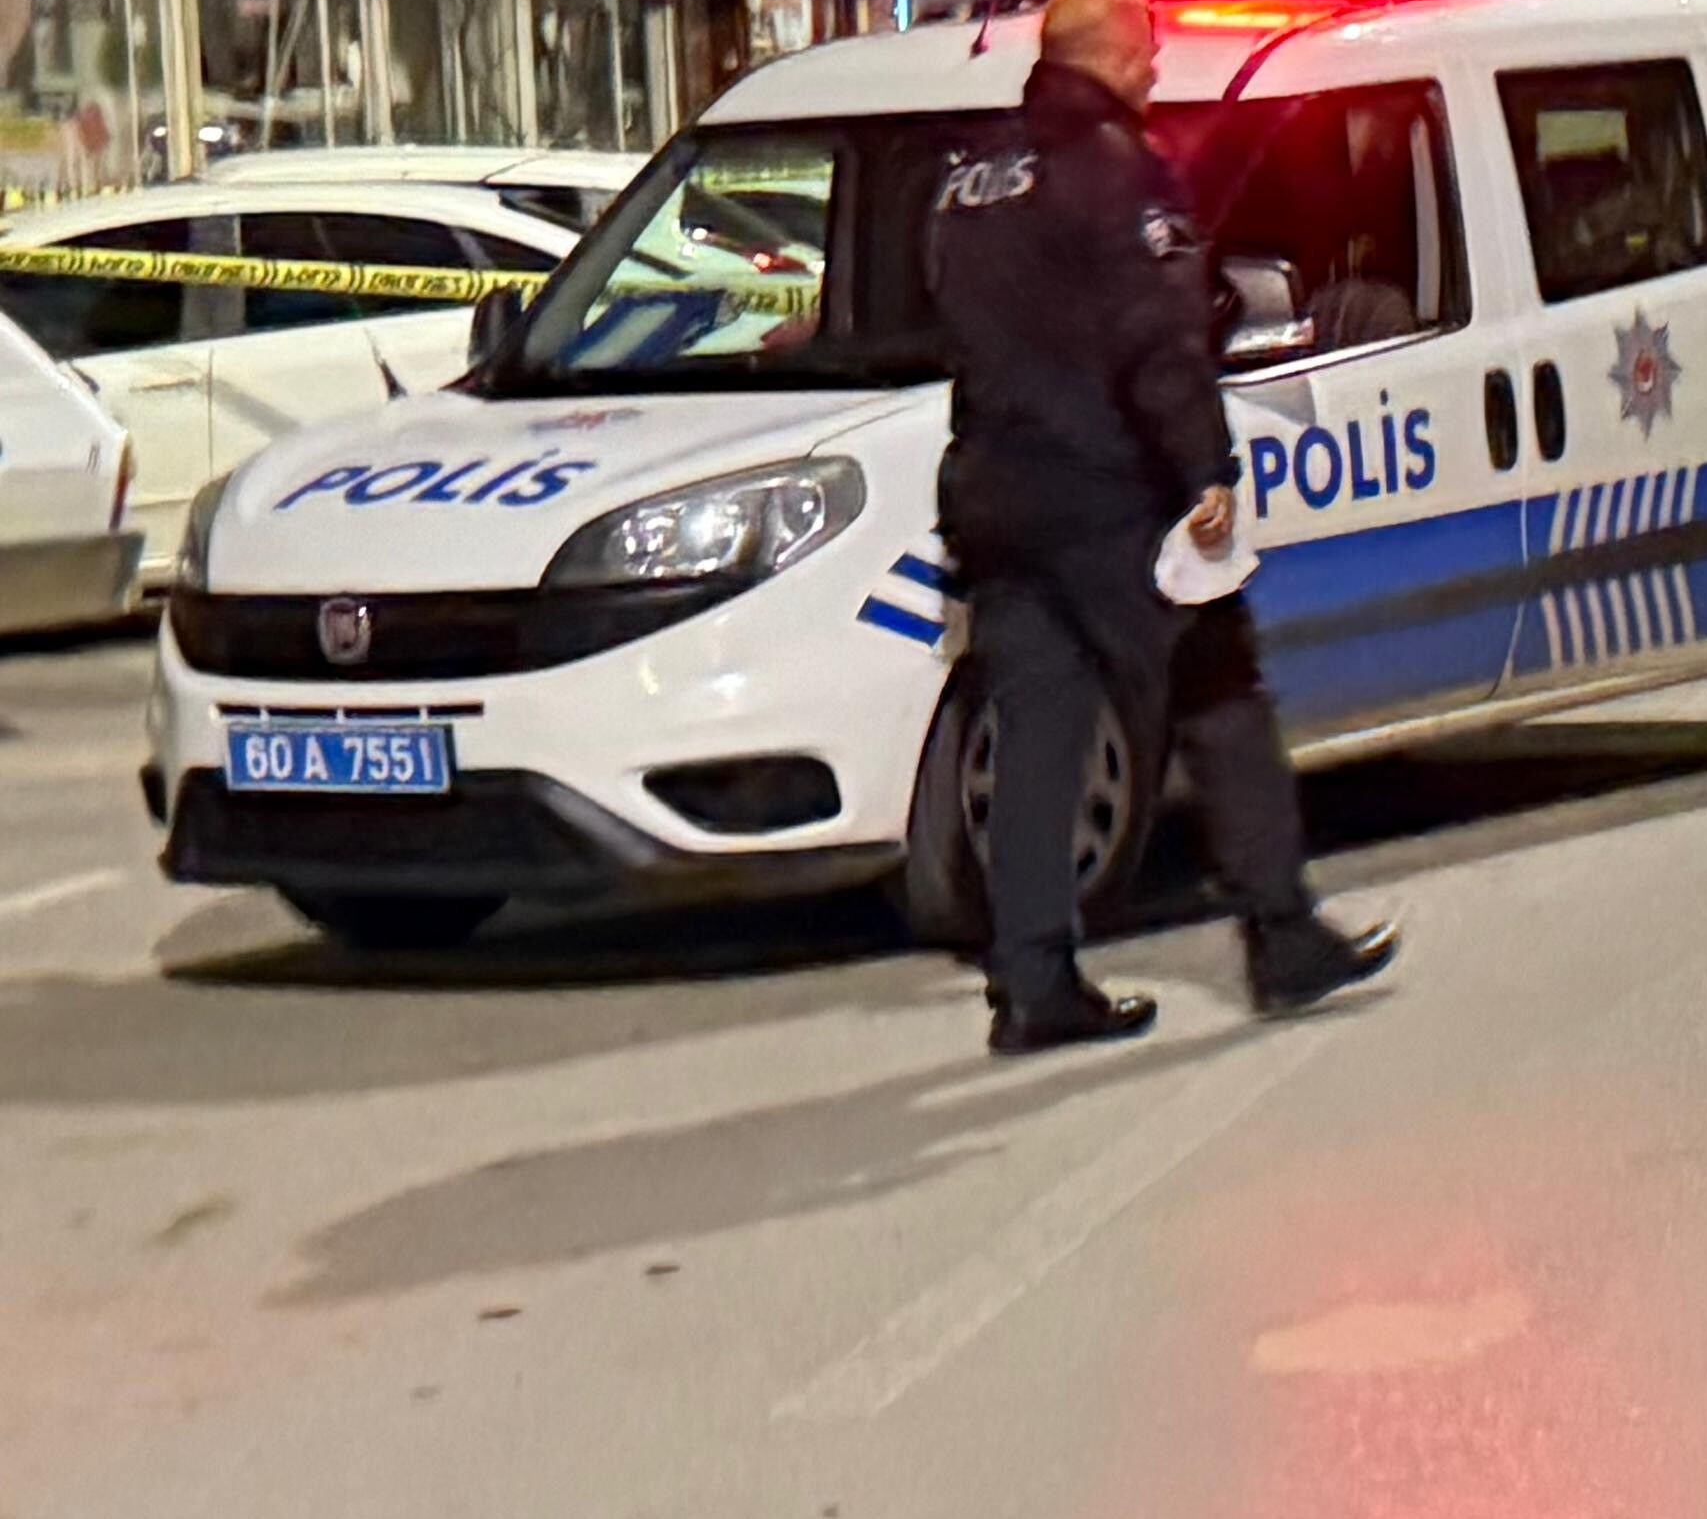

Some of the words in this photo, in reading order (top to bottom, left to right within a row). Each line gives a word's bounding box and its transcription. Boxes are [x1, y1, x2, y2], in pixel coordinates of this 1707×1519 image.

[273, 447, 598, 511] POLİS
[1250, 388, 1436, 519] POLİS
[245, 734, 293, 780] 60
[303, 734, 329, 781] A
[343, 736, 433, 782] 7551
